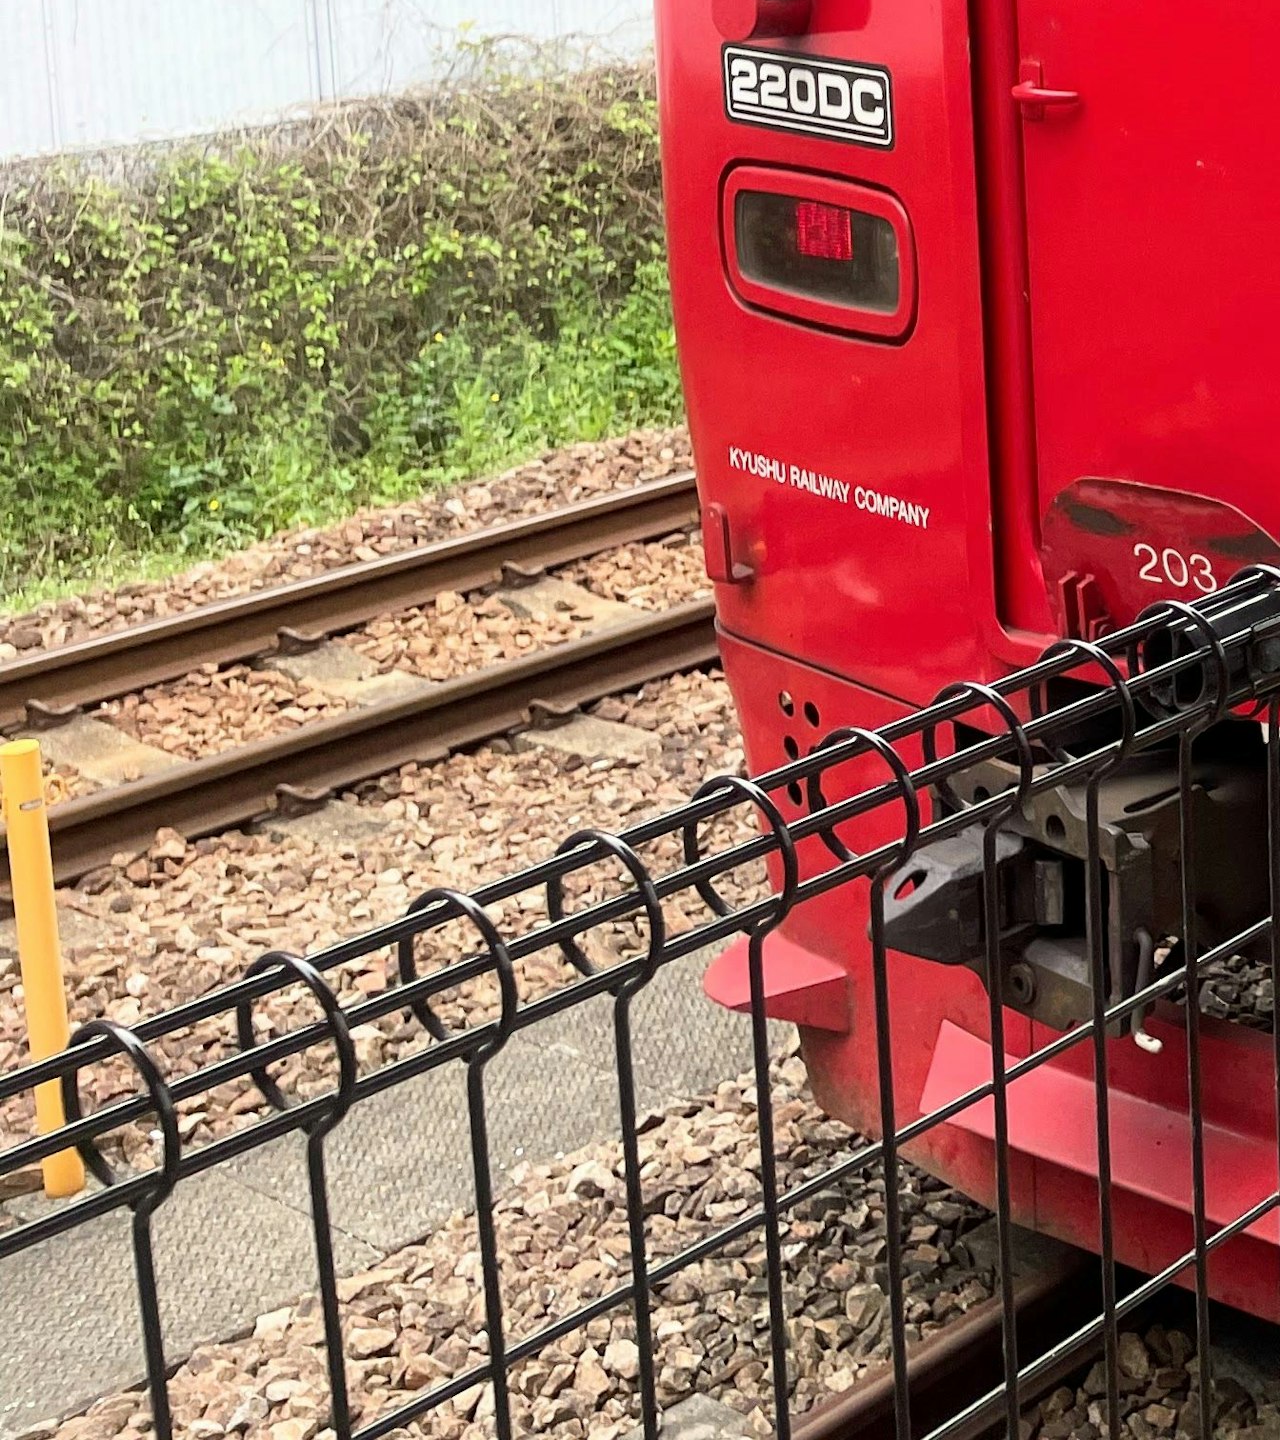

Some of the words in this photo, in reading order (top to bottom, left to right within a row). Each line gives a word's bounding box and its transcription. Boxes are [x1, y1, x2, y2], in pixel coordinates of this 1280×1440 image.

[731, 58, 885, 127] 220DC
[729, 446, 786, 483] KYUSHU
[789, 464, 850, 504] RAILWAY
[854, 485, 930, 529] COMPANY
[1132, 542, 1218, 594] 203
